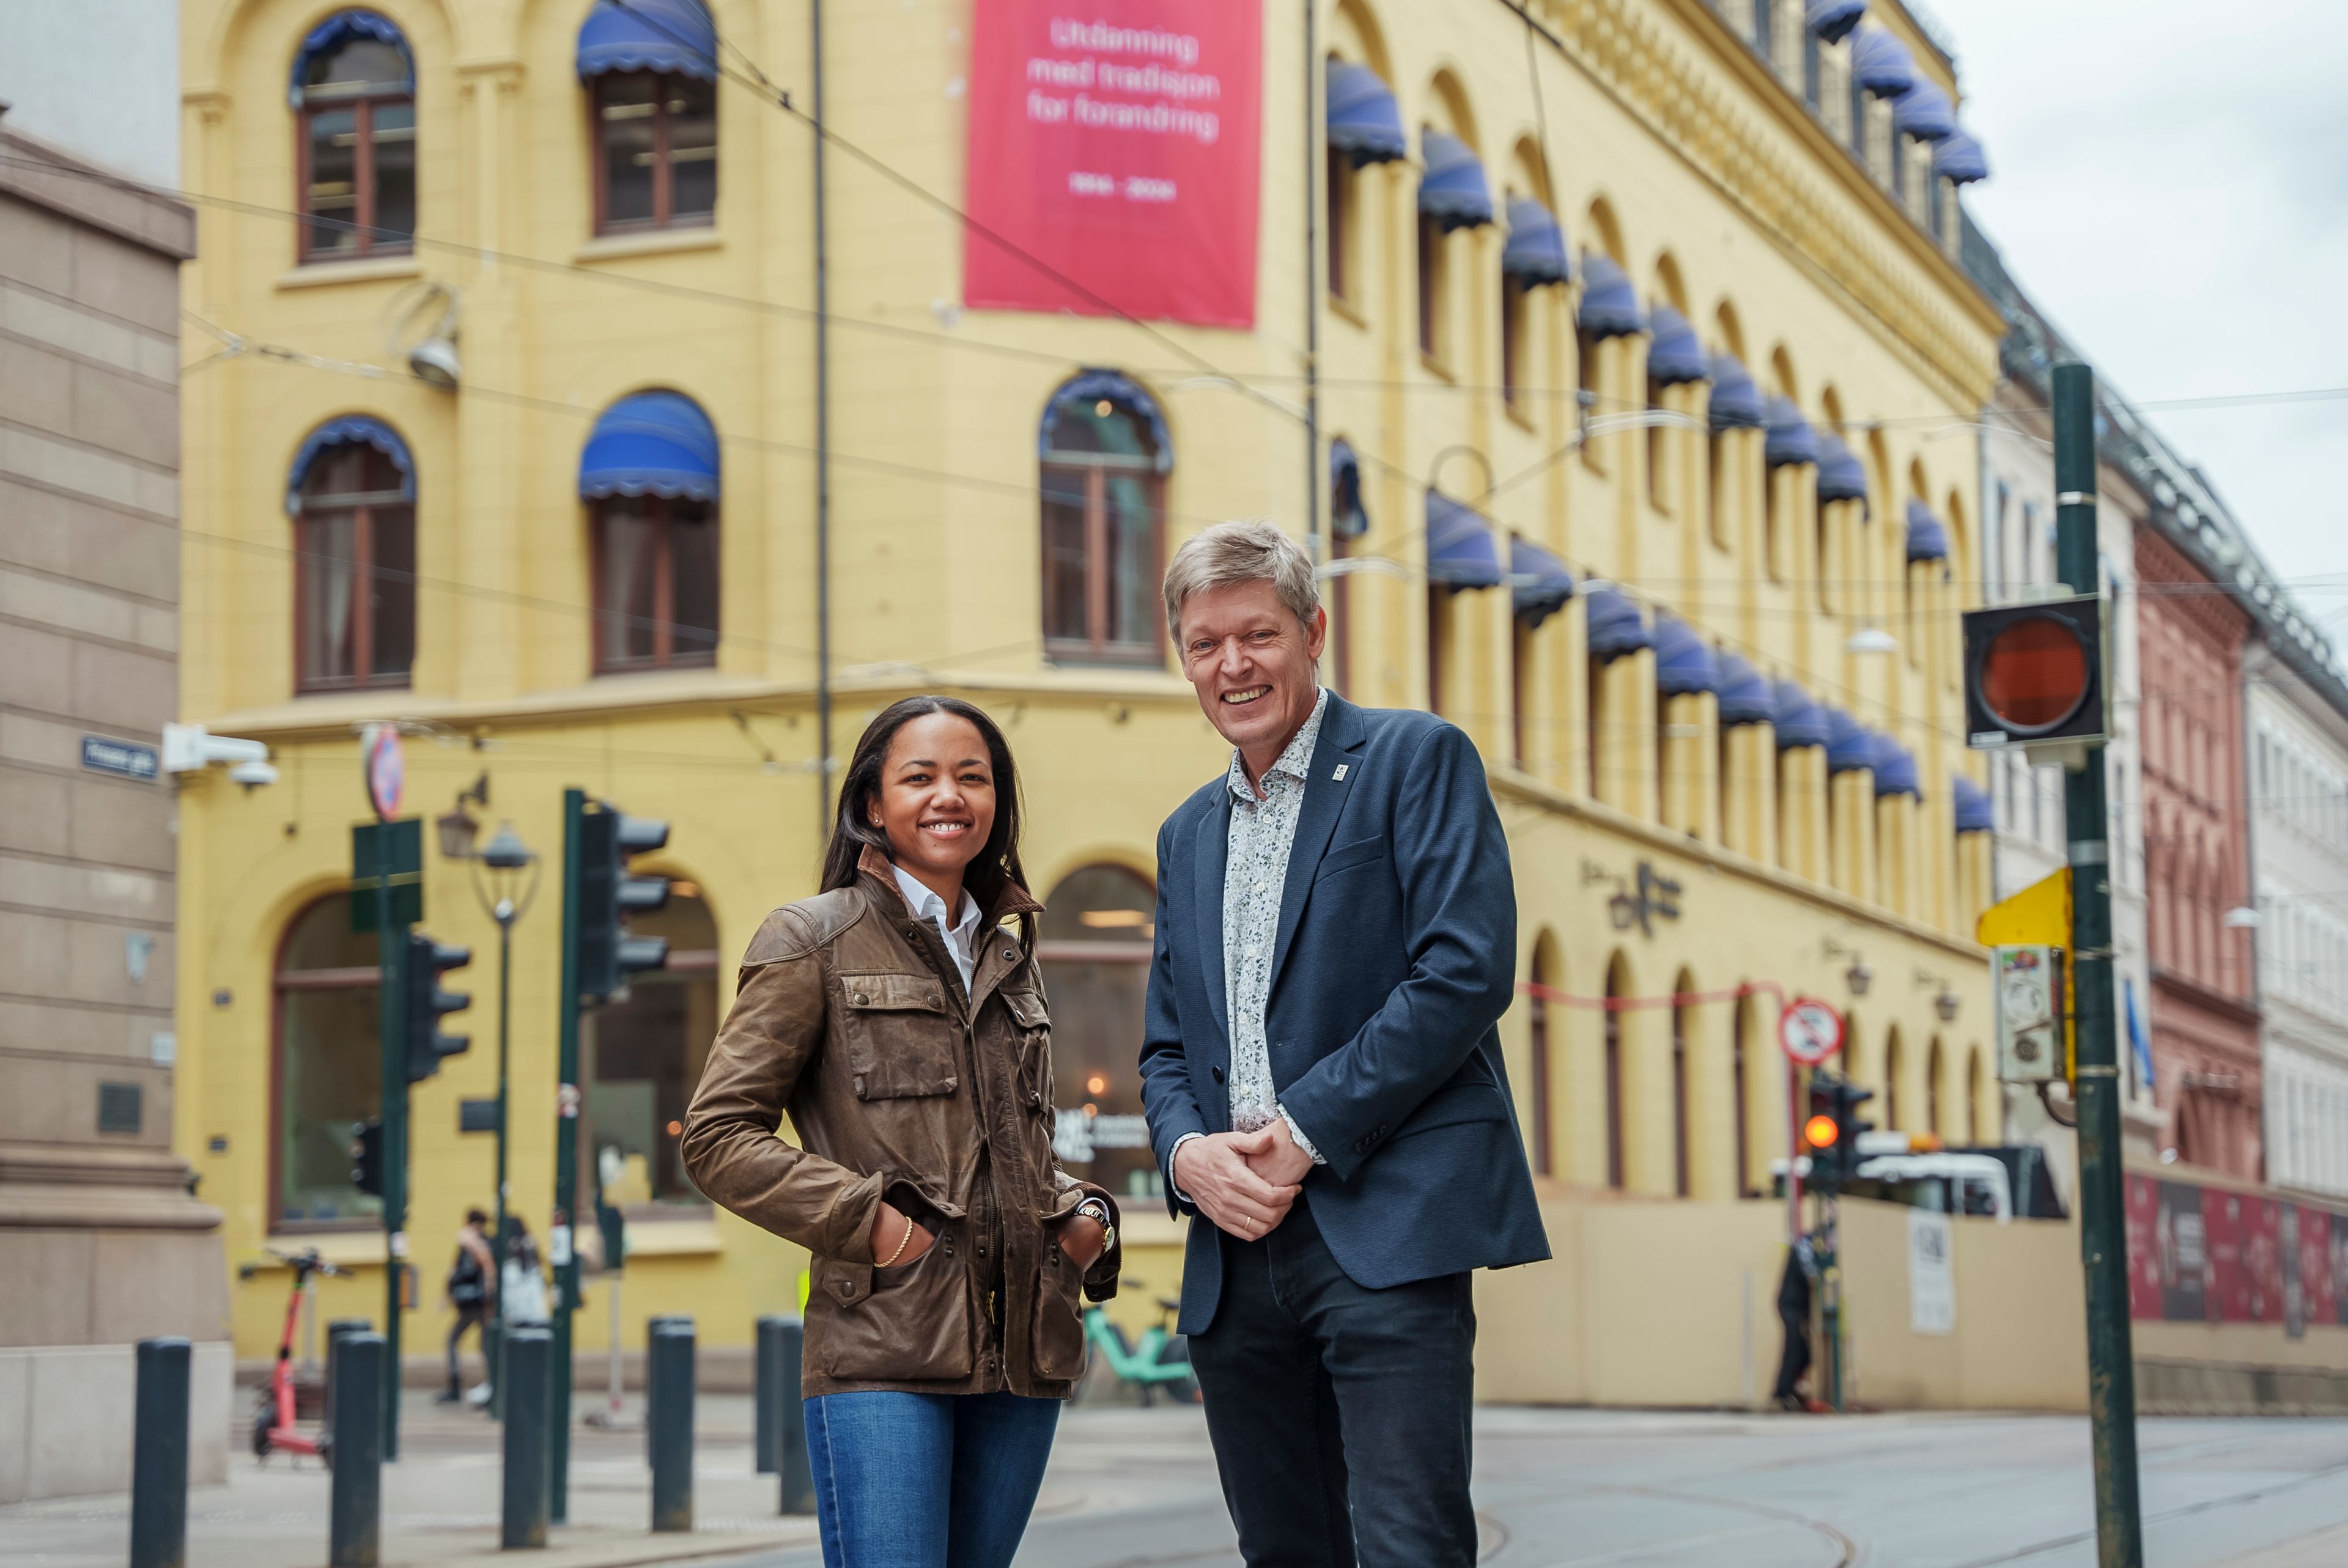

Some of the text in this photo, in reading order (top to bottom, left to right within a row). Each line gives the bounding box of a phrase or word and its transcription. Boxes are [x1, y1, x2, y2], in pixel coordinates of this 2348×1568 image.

[1050, 17, 1198, 66] Utdanning
[1028, 56, 1219, 100] med tradisjon
[1027, 89, 1219, 144] for forandring
